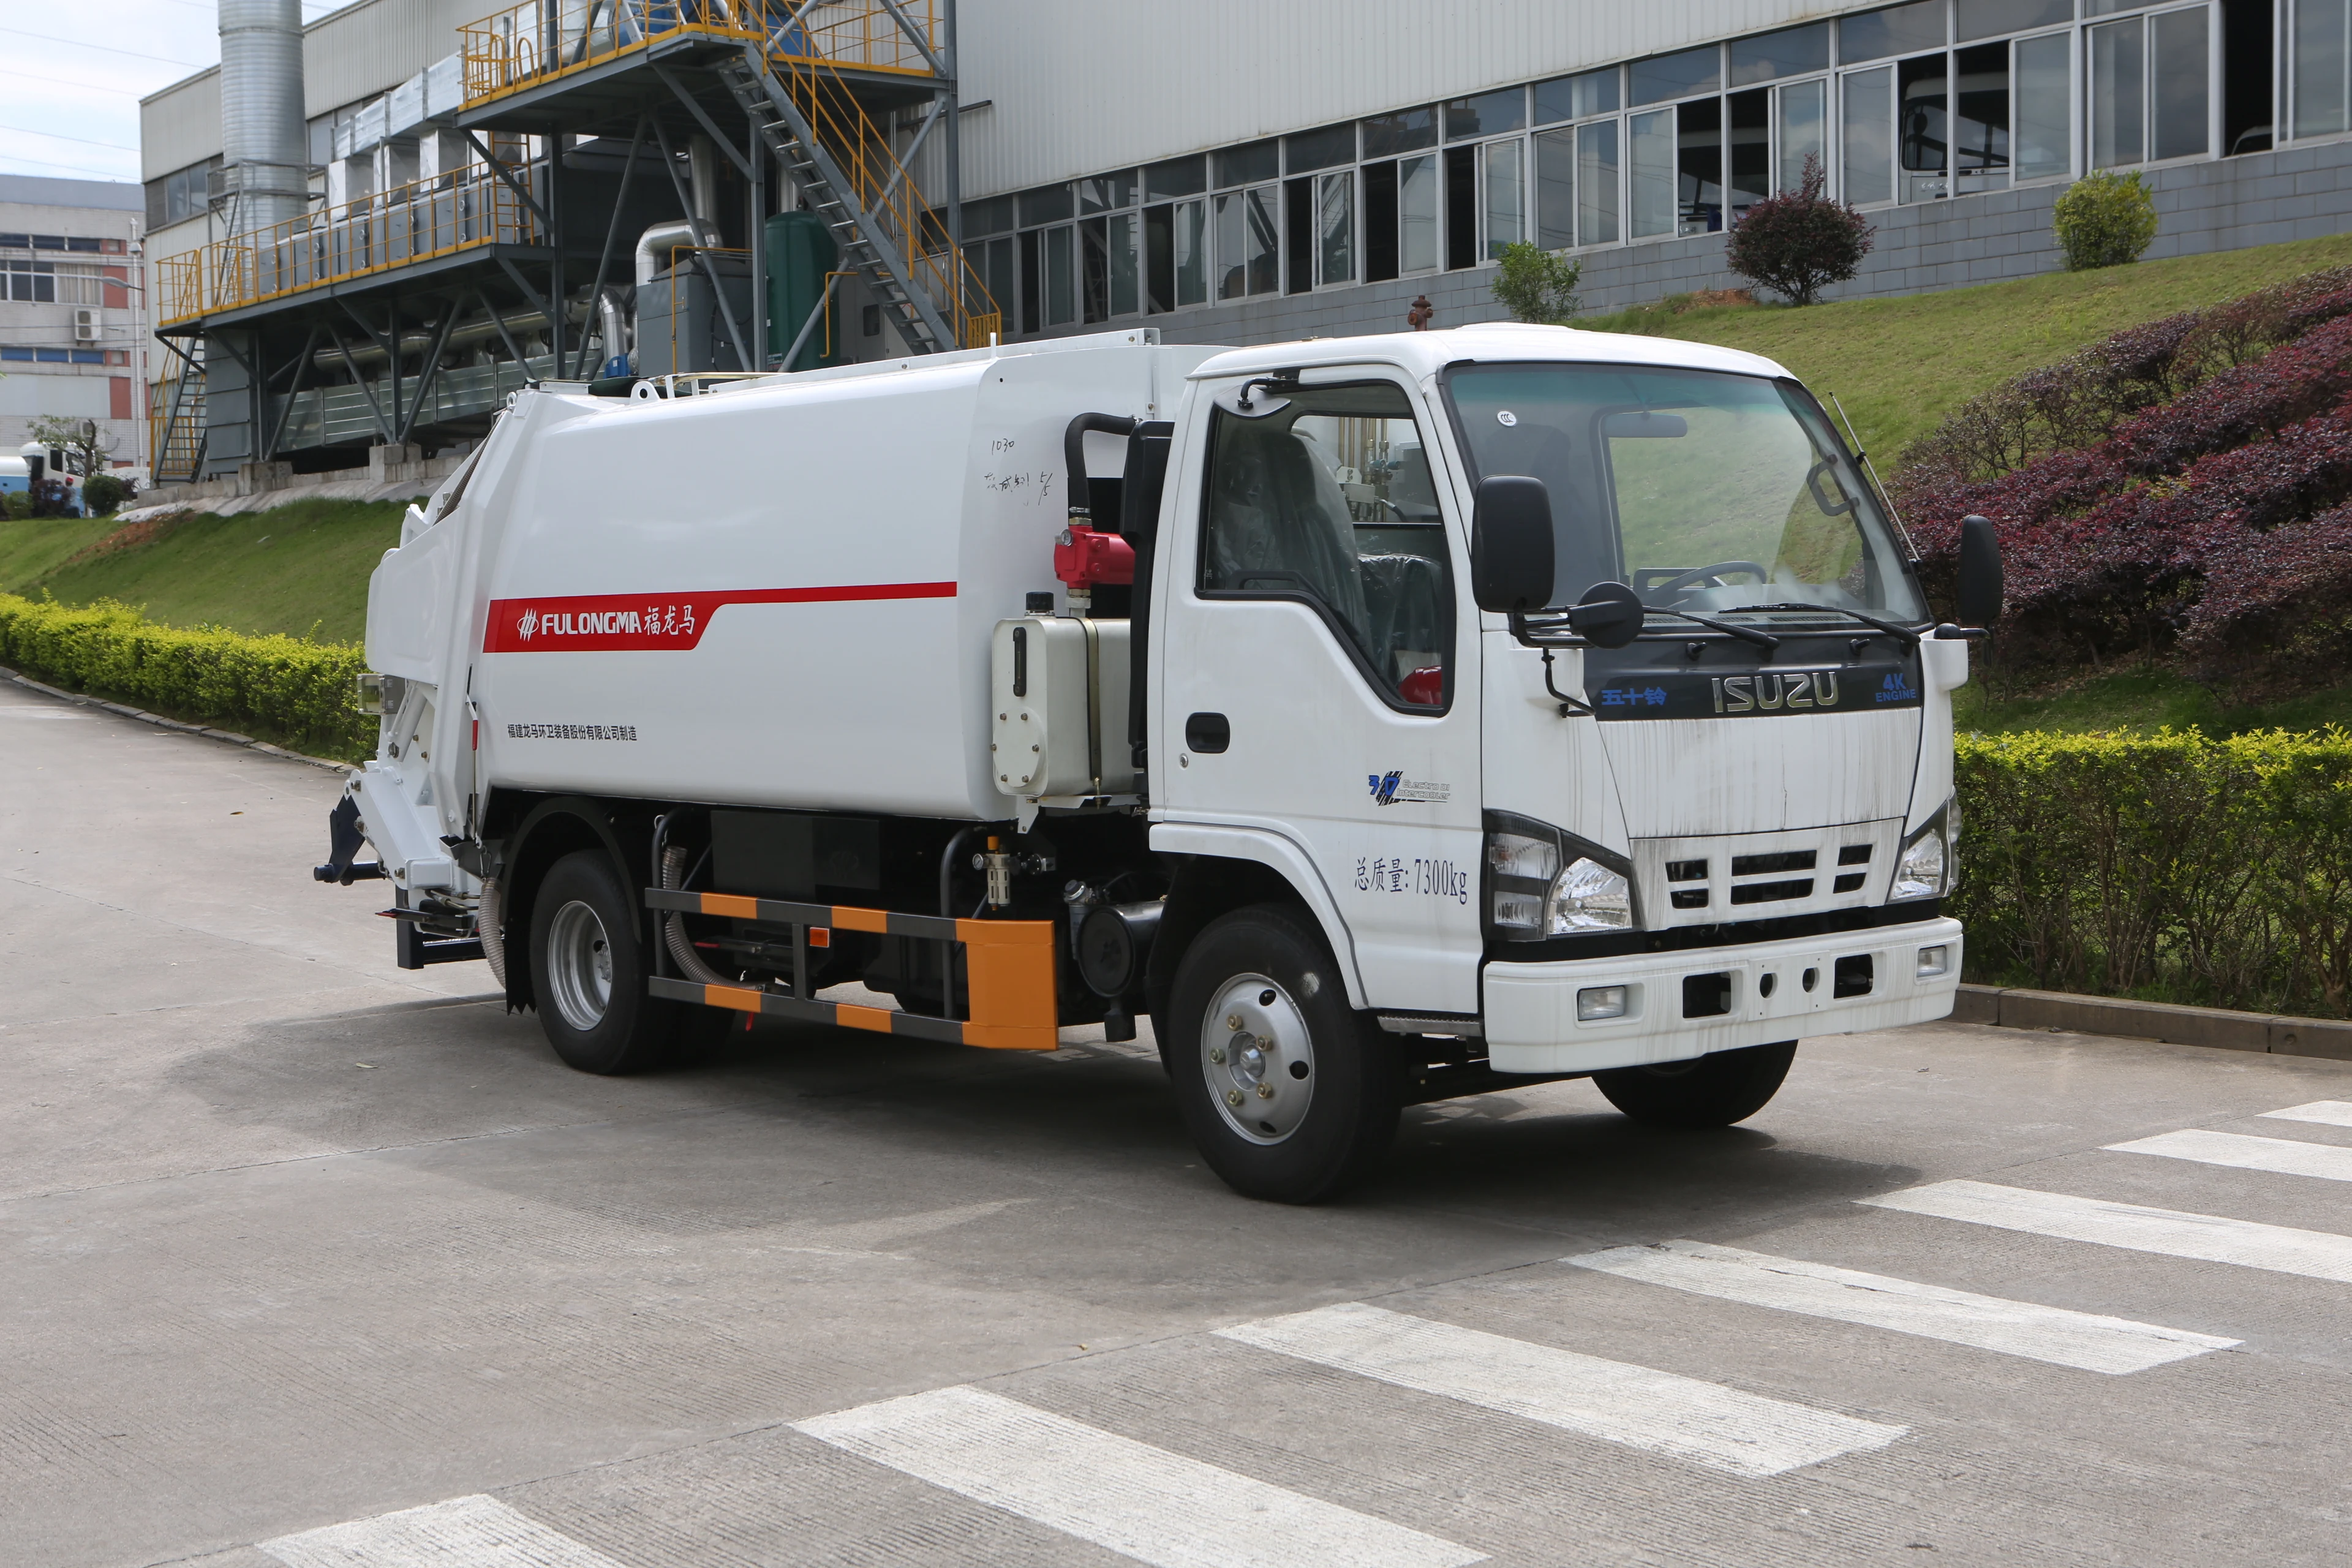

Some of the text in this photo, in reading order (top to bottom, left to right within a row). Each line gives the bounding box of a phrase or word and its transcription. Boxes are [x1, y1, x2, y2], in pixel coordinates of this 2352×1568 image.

[991, 438, 1015, 455] 1030
[541, 604, 696, 636] FULONGMA 福龙马
[1883, 673, 1907, 691] 4K
[1601, 687, 1667, 706] 五十铃
[1711, 671, 1839, 712] ISUZU
[1875, 688, 1917, 703] ENGINE
[507, 723, 638, 741] 福建龙马环卫装备股份有限公司制造
